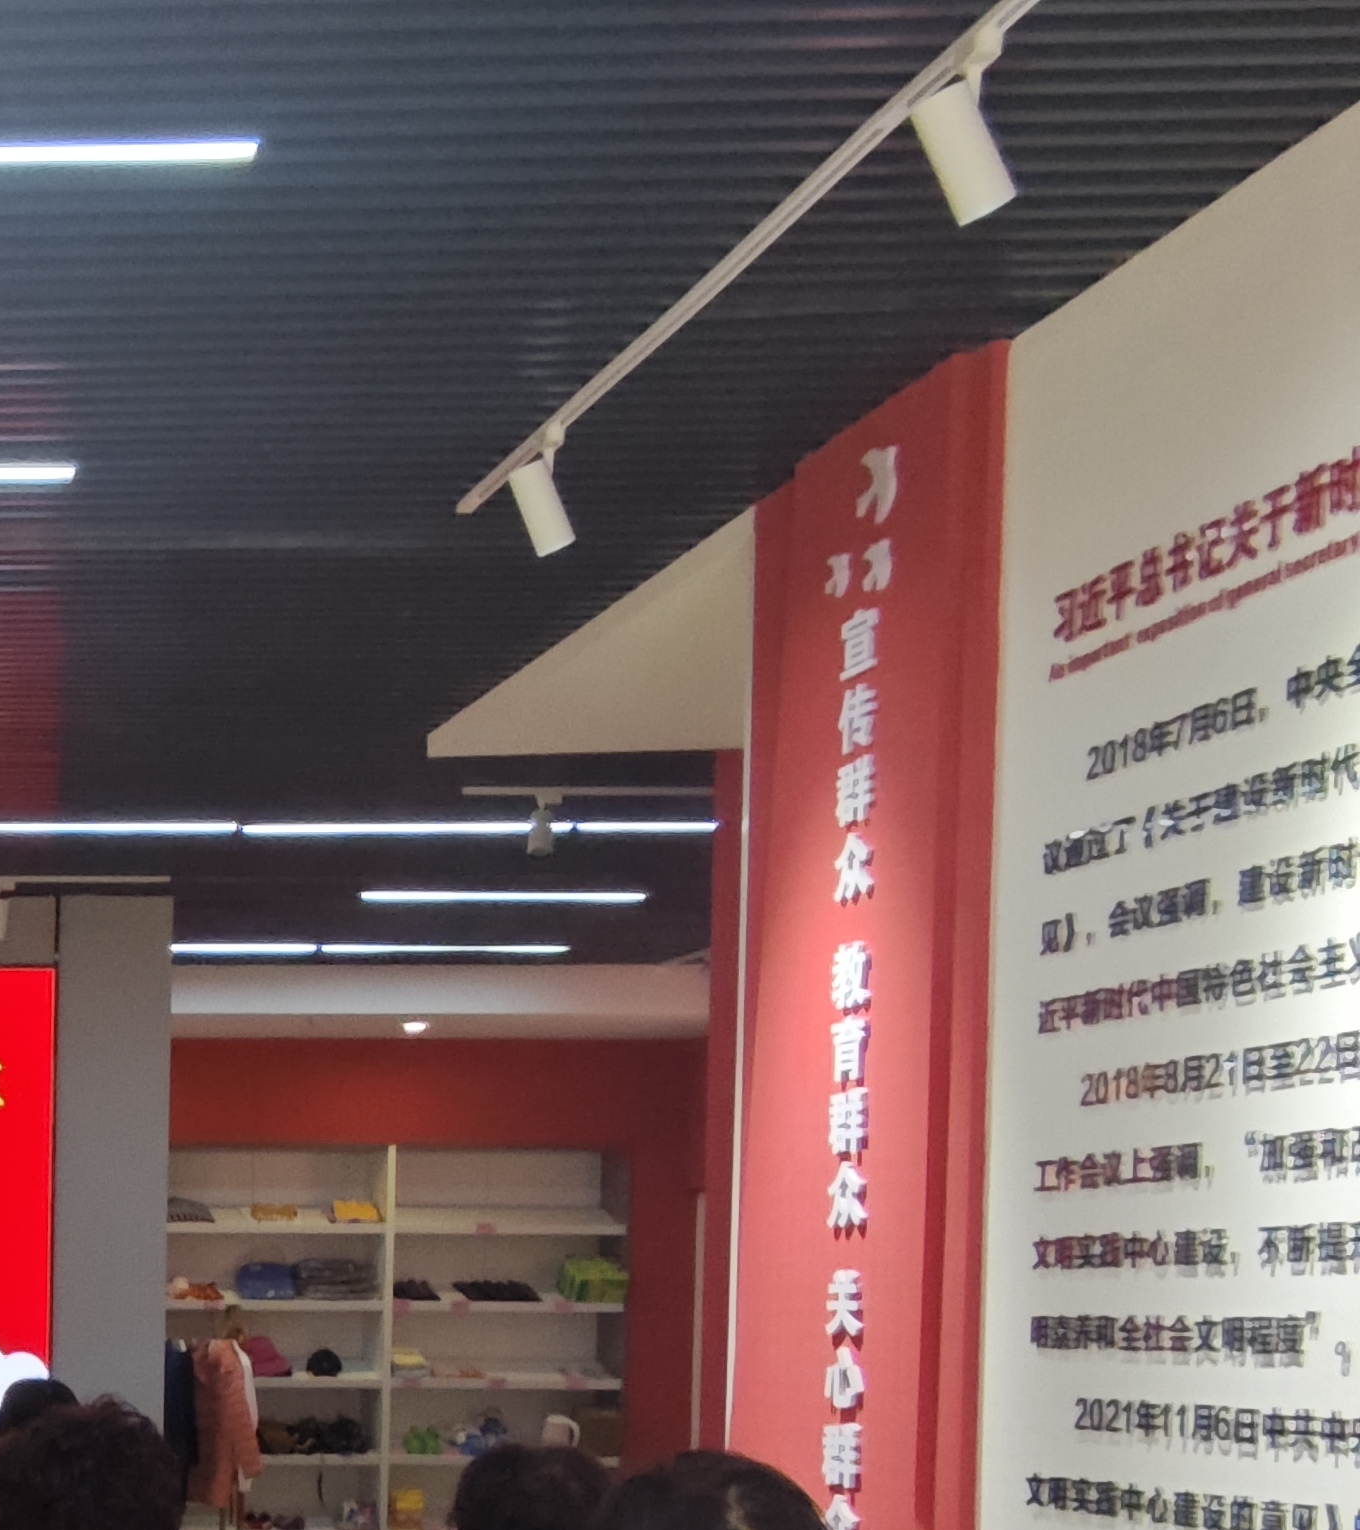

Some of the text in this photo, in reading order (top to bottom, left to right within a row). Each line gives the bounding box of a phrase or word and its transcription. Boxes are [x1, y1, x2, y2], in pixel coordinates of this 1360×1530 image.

[834, 607, 880, 902] 宣传群众
[828, 940, 871, 1230] 教育群众
[1074, 1398, 1360, 1451] 2021年11月6日中共中
